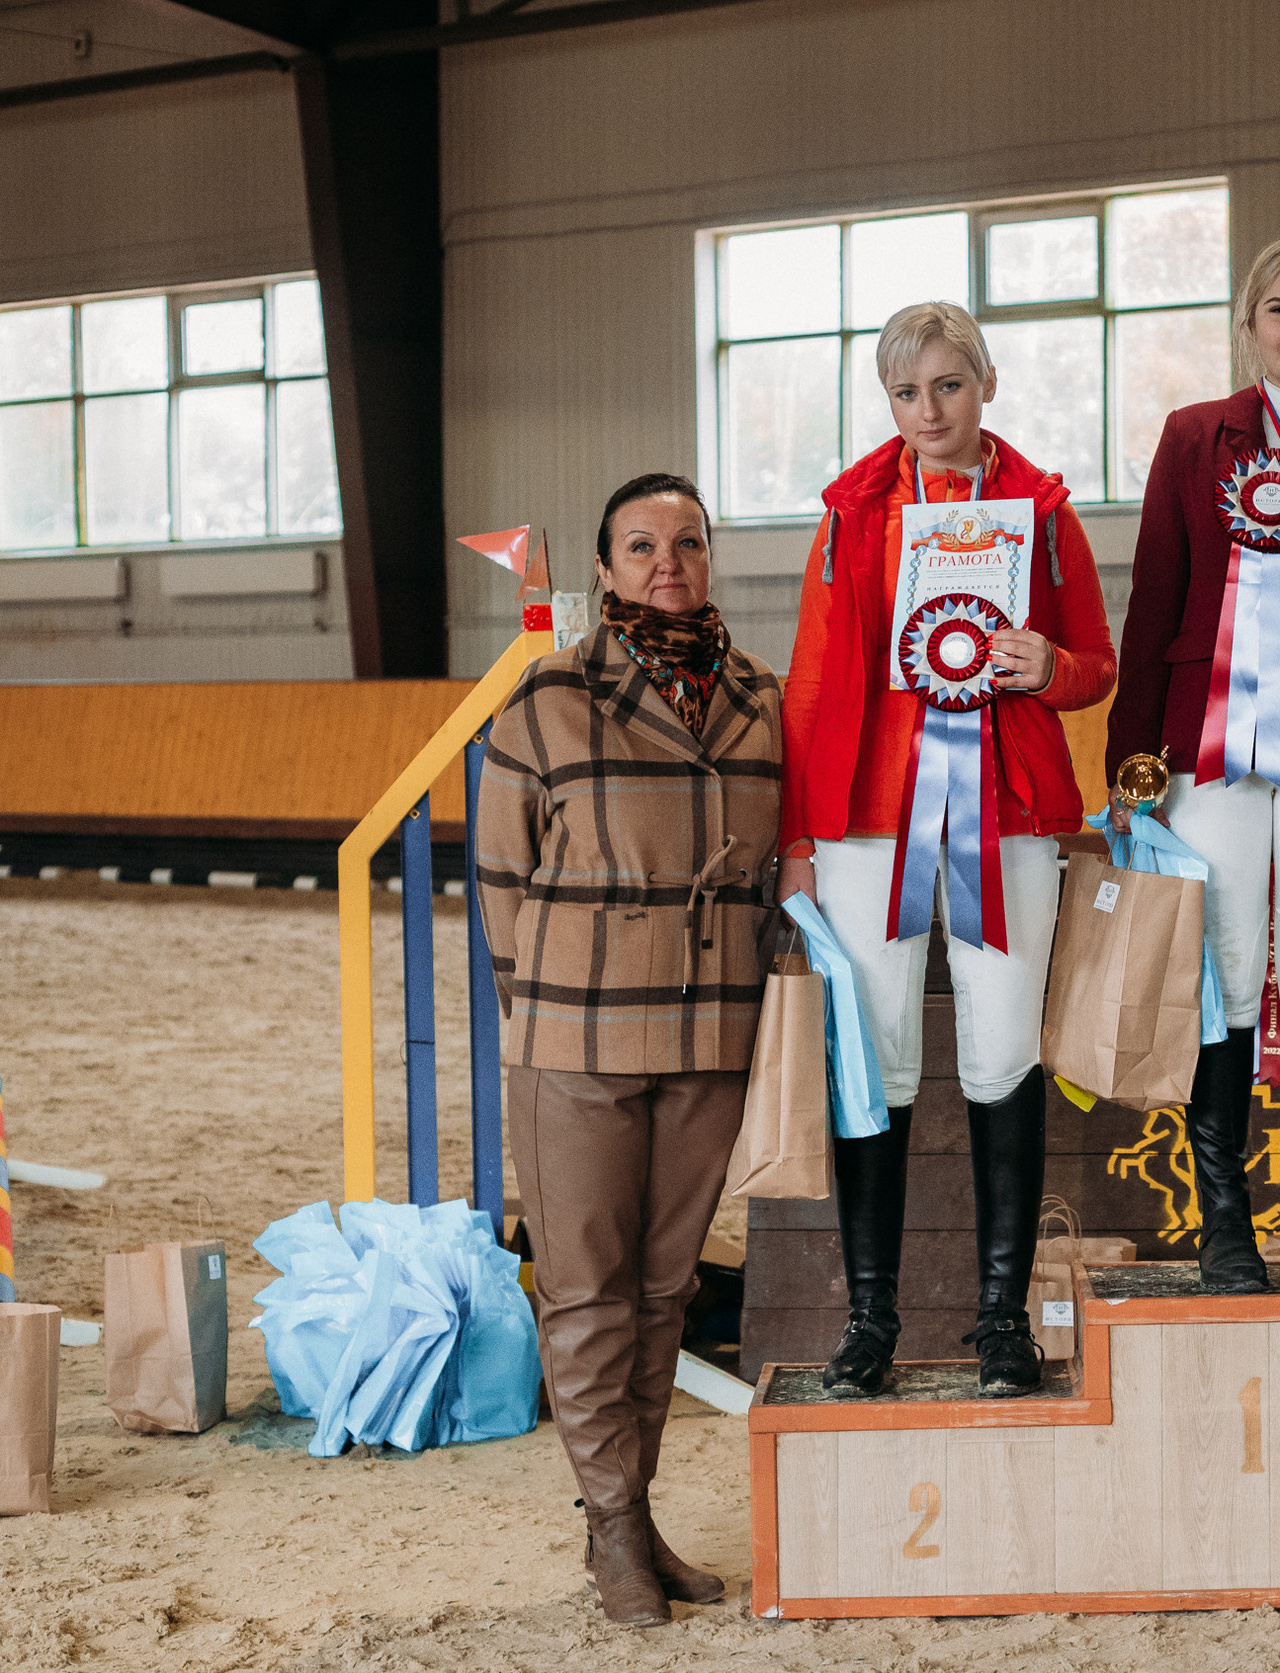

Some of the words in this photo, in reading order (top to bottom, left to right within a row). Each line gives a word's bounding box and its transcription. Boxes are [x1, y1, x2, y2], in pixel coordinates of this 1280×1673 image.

[928, 553, 1003, 568] ГРАМОТА
[1267, 1000, 1278, 1039] Финал
[1237, 1376, 1265, 1474] 1
[902, 1482, 941, 1559] 2
